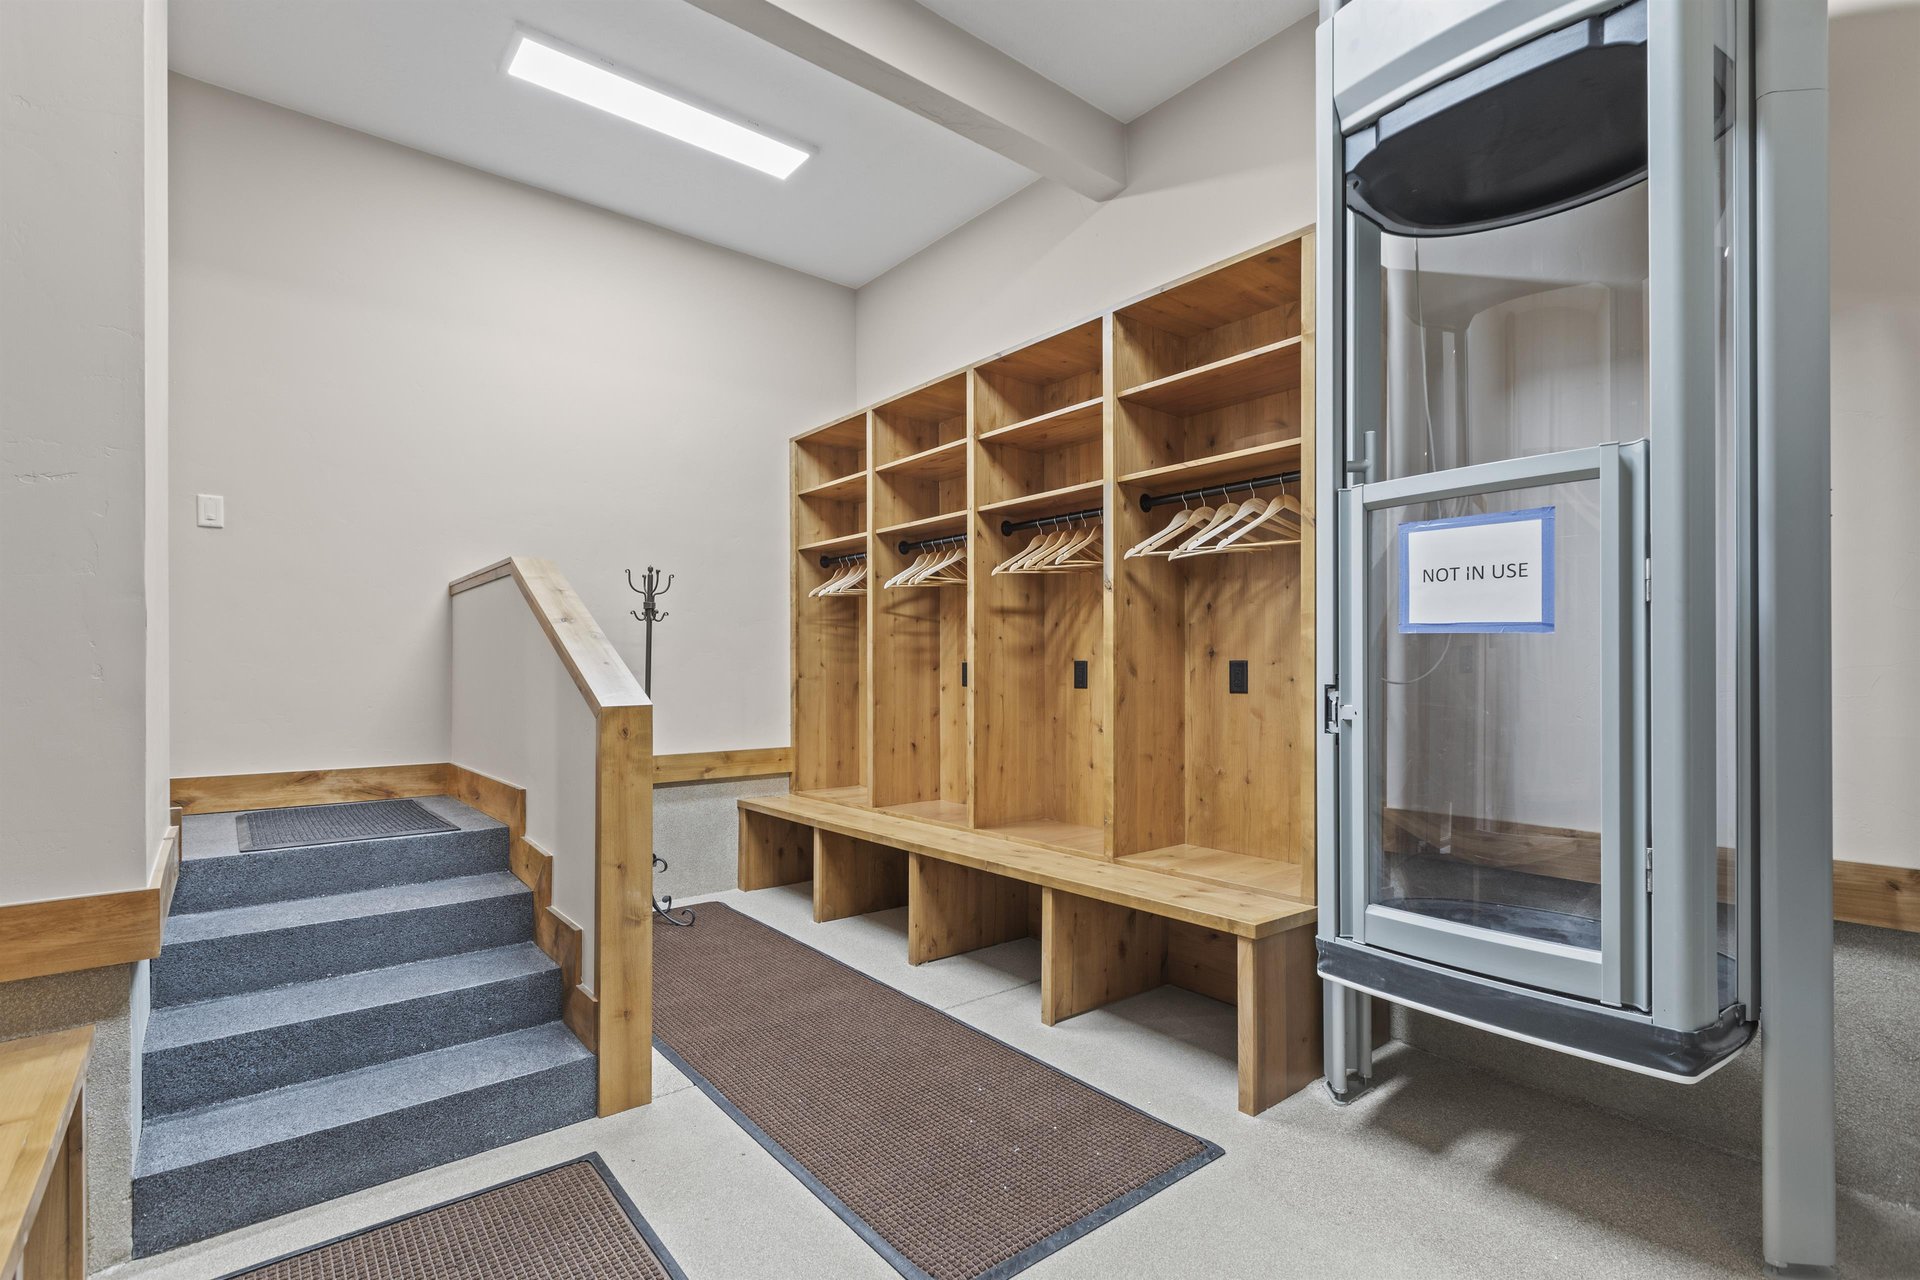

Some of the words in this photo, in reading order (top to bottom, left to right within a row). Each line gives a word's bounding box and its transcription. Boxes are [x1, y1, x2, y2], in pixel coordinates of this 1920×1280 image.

[1422, 567, 1461, 583] NOT
[1466, 565, 1485, 581] IN
[1492, 562, 1529, 579] USE
